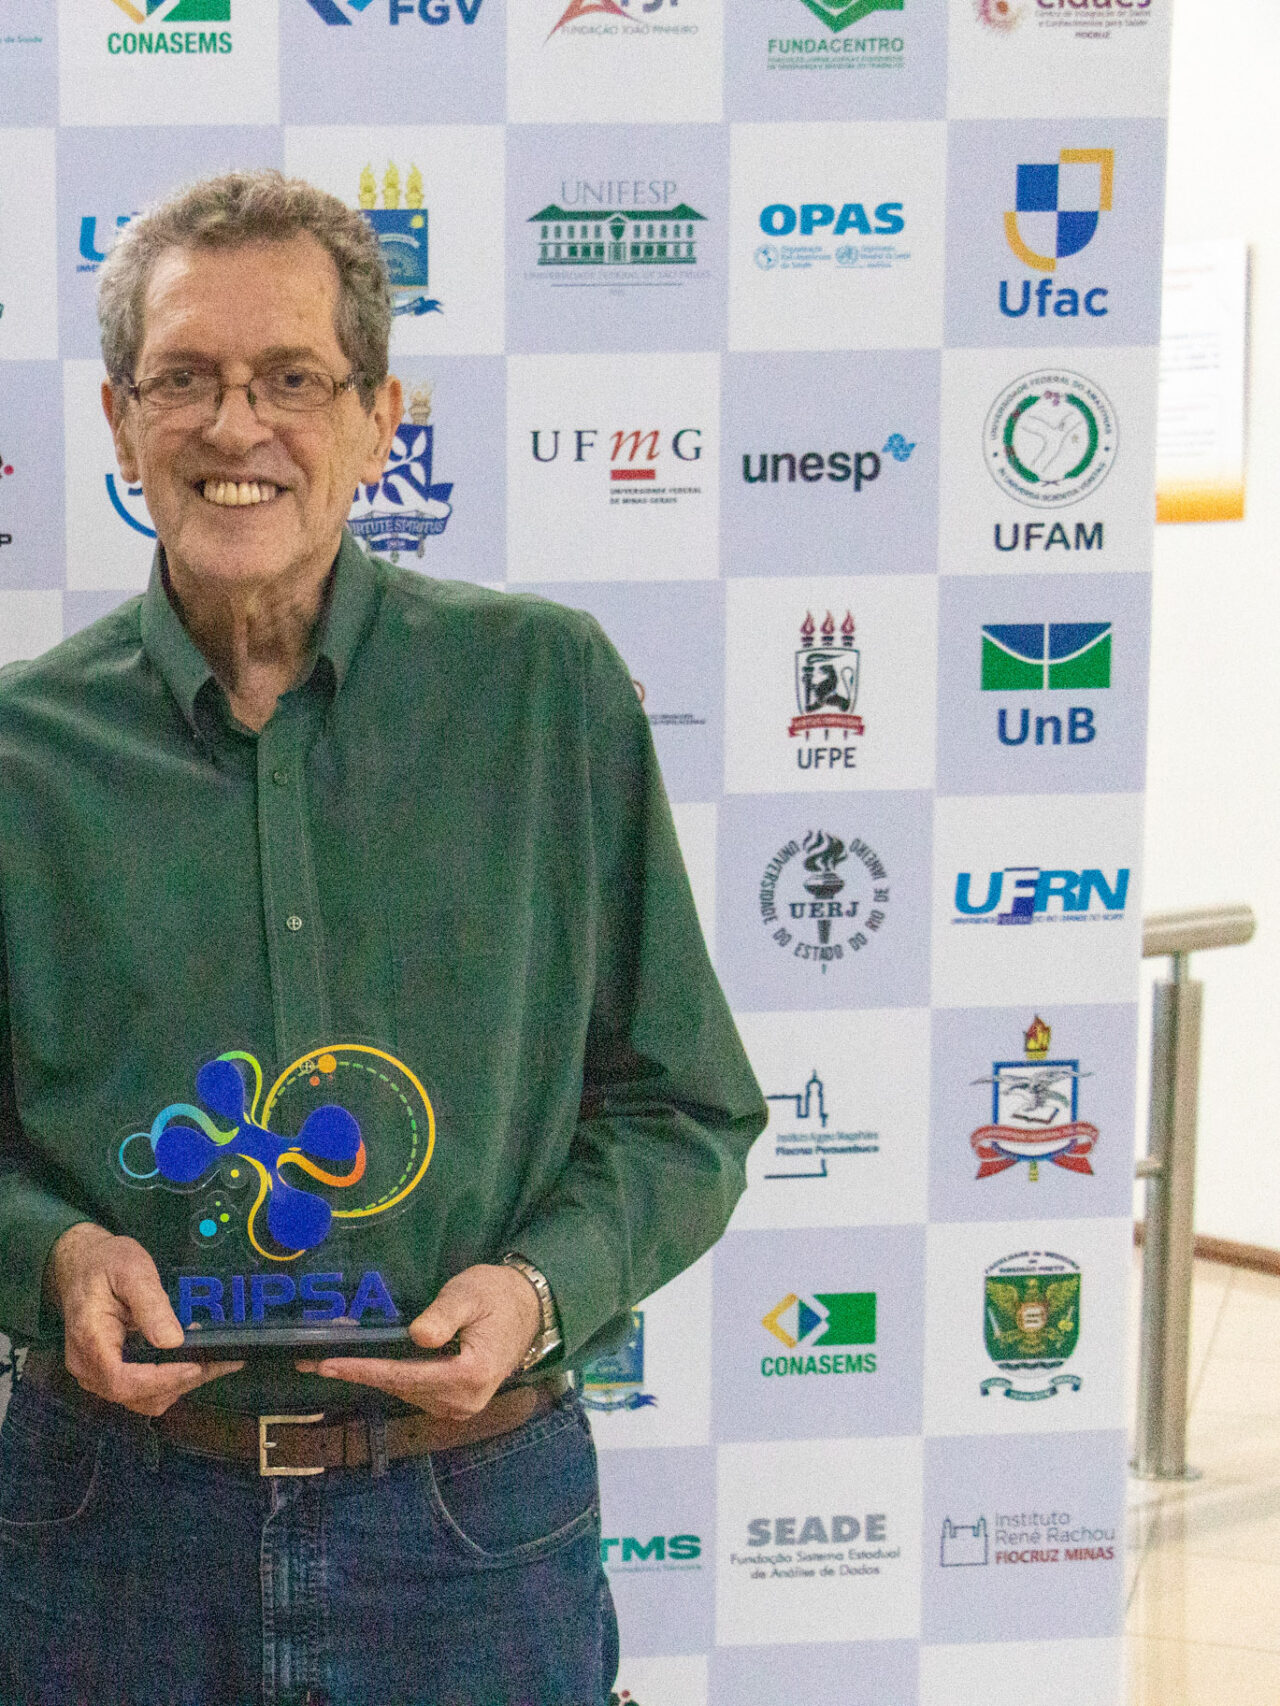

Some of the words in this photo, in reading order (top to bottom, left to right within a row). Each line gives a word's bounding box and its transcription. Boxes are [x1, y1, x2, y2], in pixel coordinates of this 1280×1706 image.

[388, 0, 482, 26] FGV
[107, 31, 232, 55] CONASEMS
[767, 37, 905, 54] FUNDACENTRO
[561, 180, 677, 205] UNIFESP
[759, 202, 906, 237] OPAS
[998, 278, 1109, 319] Ufac
[1030, 375, 1069, 387] FEDERAL
[741, 451, 881, 492] unesp
[994, 521, 1104, 551] UFAM
[997, 707, 1096, 747] UnB
[797, 747, 857, 770] UFPE
[849, 838, 887, 880] JANEIRO
[759, 840, 800, 925] UNIVERSIDADE
[873, 887, 889, 903] DE
[954, 867, 1131, 922] UFRN
[788, 901, 859, 919] UERJ
[864, 909, 885, 932] RIO
[772, 927, 792, 947] DO
[848, 932, 868, 952] DO
[794, 942, 844, 961] ESTADO
[178, 1270, 401, 1324] RIPSA
[761, 1352, 877, 1377] CONASEMS
[747, 1514, 887, 1547] SEADE
[995, 1511, 1071, 1527] Instituto
[995, 1529, 1041, 1545] René
[1047, 1526, 1115, 1542] Rachou
[730, 1551, 793, 1566] Fundação
[796, 1550, 844, 1562] Sistema
[848, 1547, 901, 1560] Estadual
[995, 1549, 1059, 1564] FIOCRUZ
[1064, 1546, 1115, 1561] MINAS
[750, 1568, 766, 1579] de
[771, 1566, 816, 1578] Análise
[819, 1565, 835, 1577] de
[839, 1564, 881, 1576] Dados
